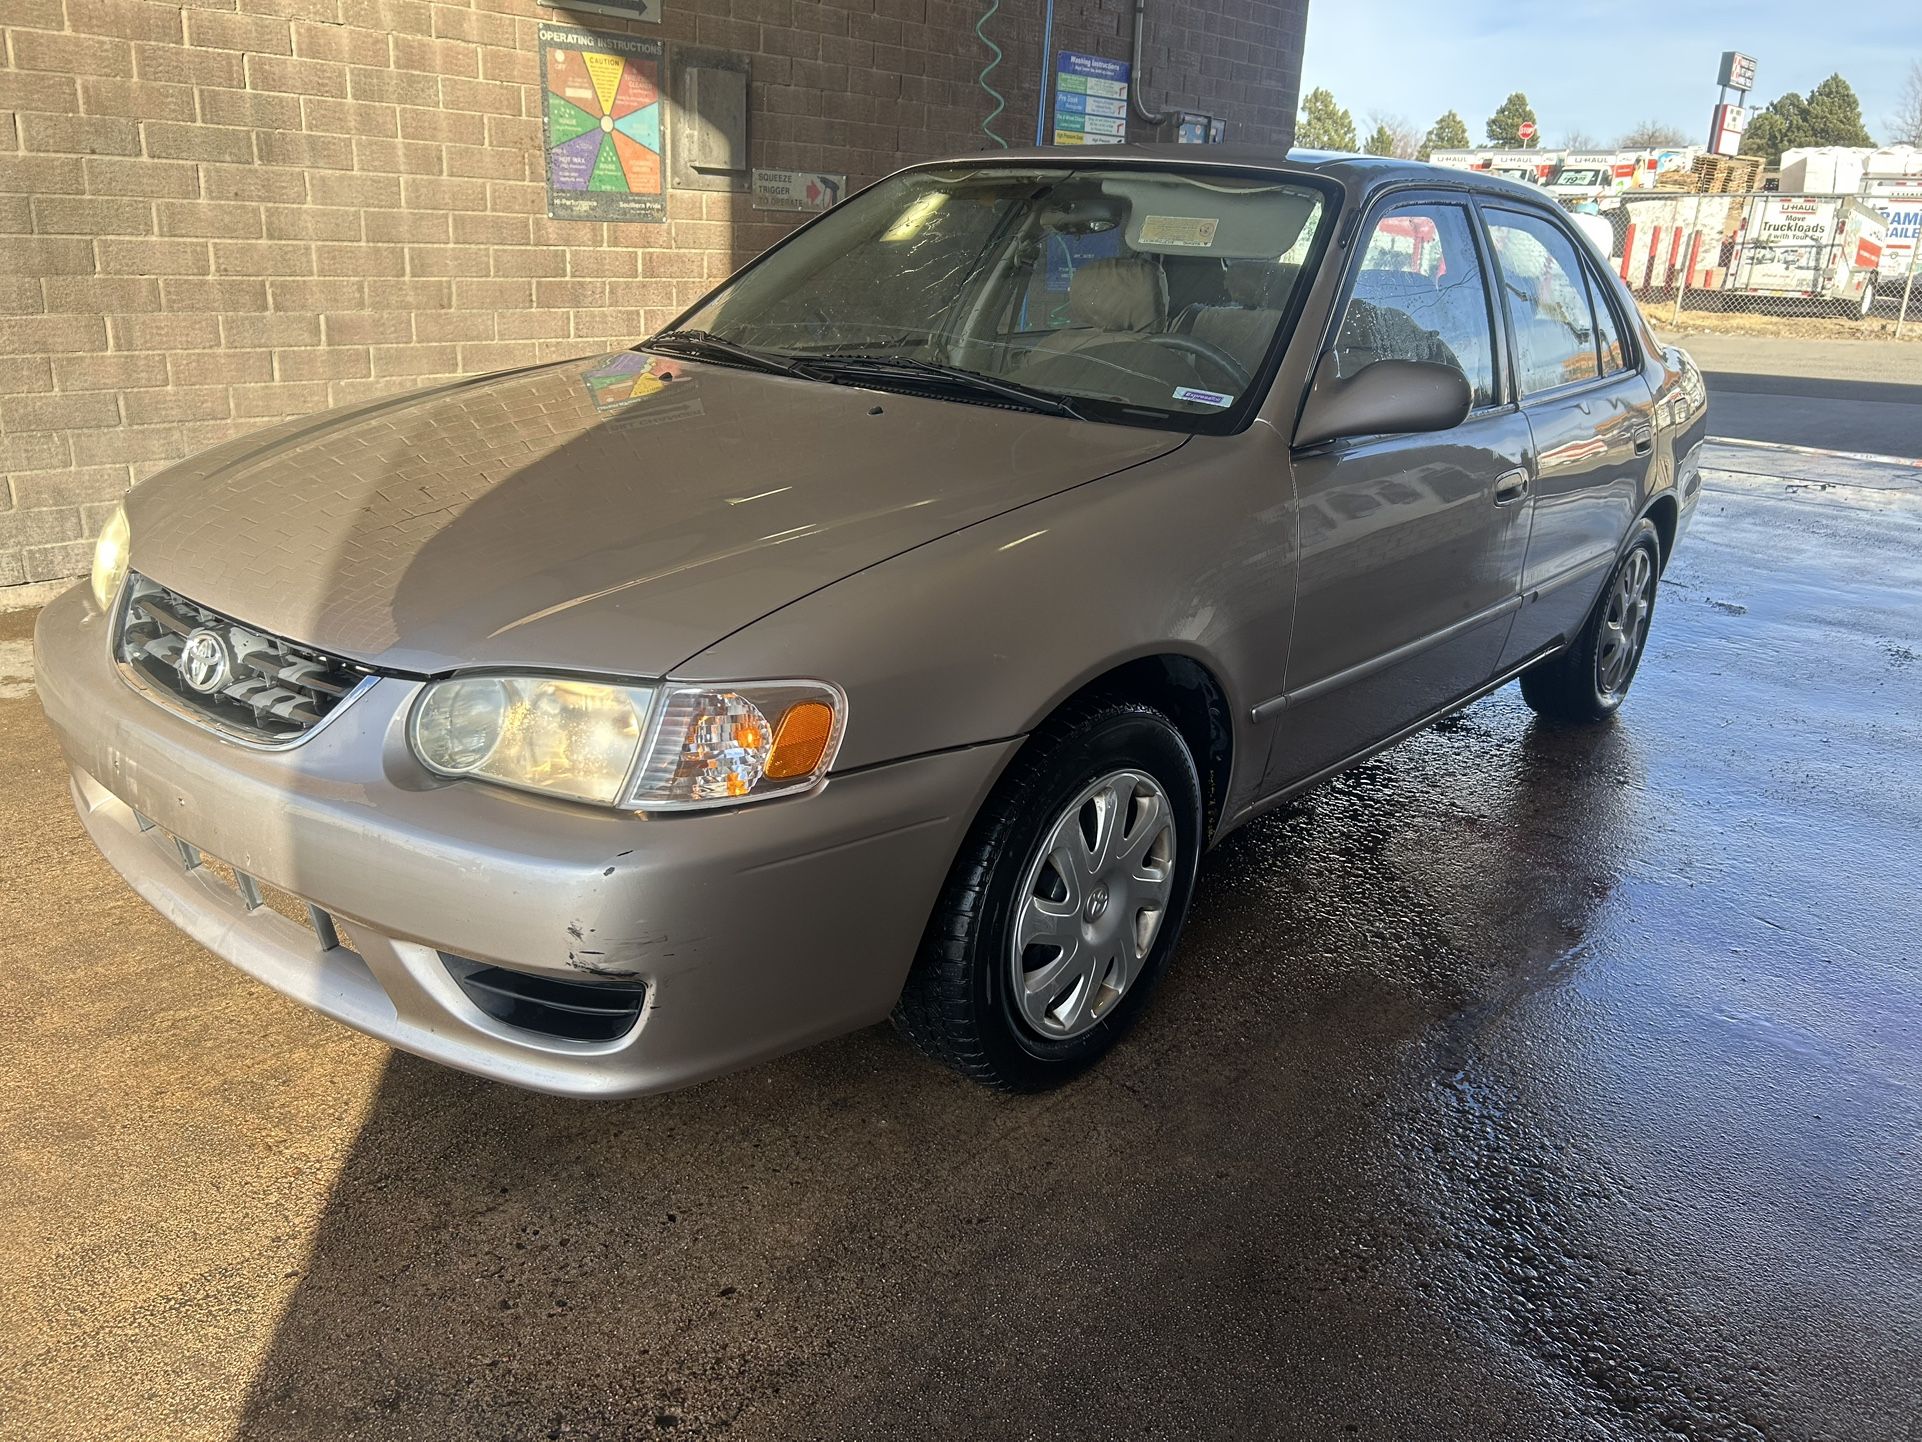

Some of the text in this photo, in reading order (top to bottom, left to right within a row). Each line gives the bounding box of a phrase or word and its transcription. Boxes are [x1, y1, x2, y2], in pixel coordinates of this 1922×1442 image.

[539, 30, 662, 56] OPERATING INSTRUCTIONS
[589, 56, 620, 67] CAUTION
[1070, 55, 1091, 68] Washing
[1092, 58, 1120, 71] Instructions
[758, 173, 793, 184] SQUEEZE
[758, 186, 790, 196] TRIGGER
[1763, 222, 1826, 233] Truckloads
